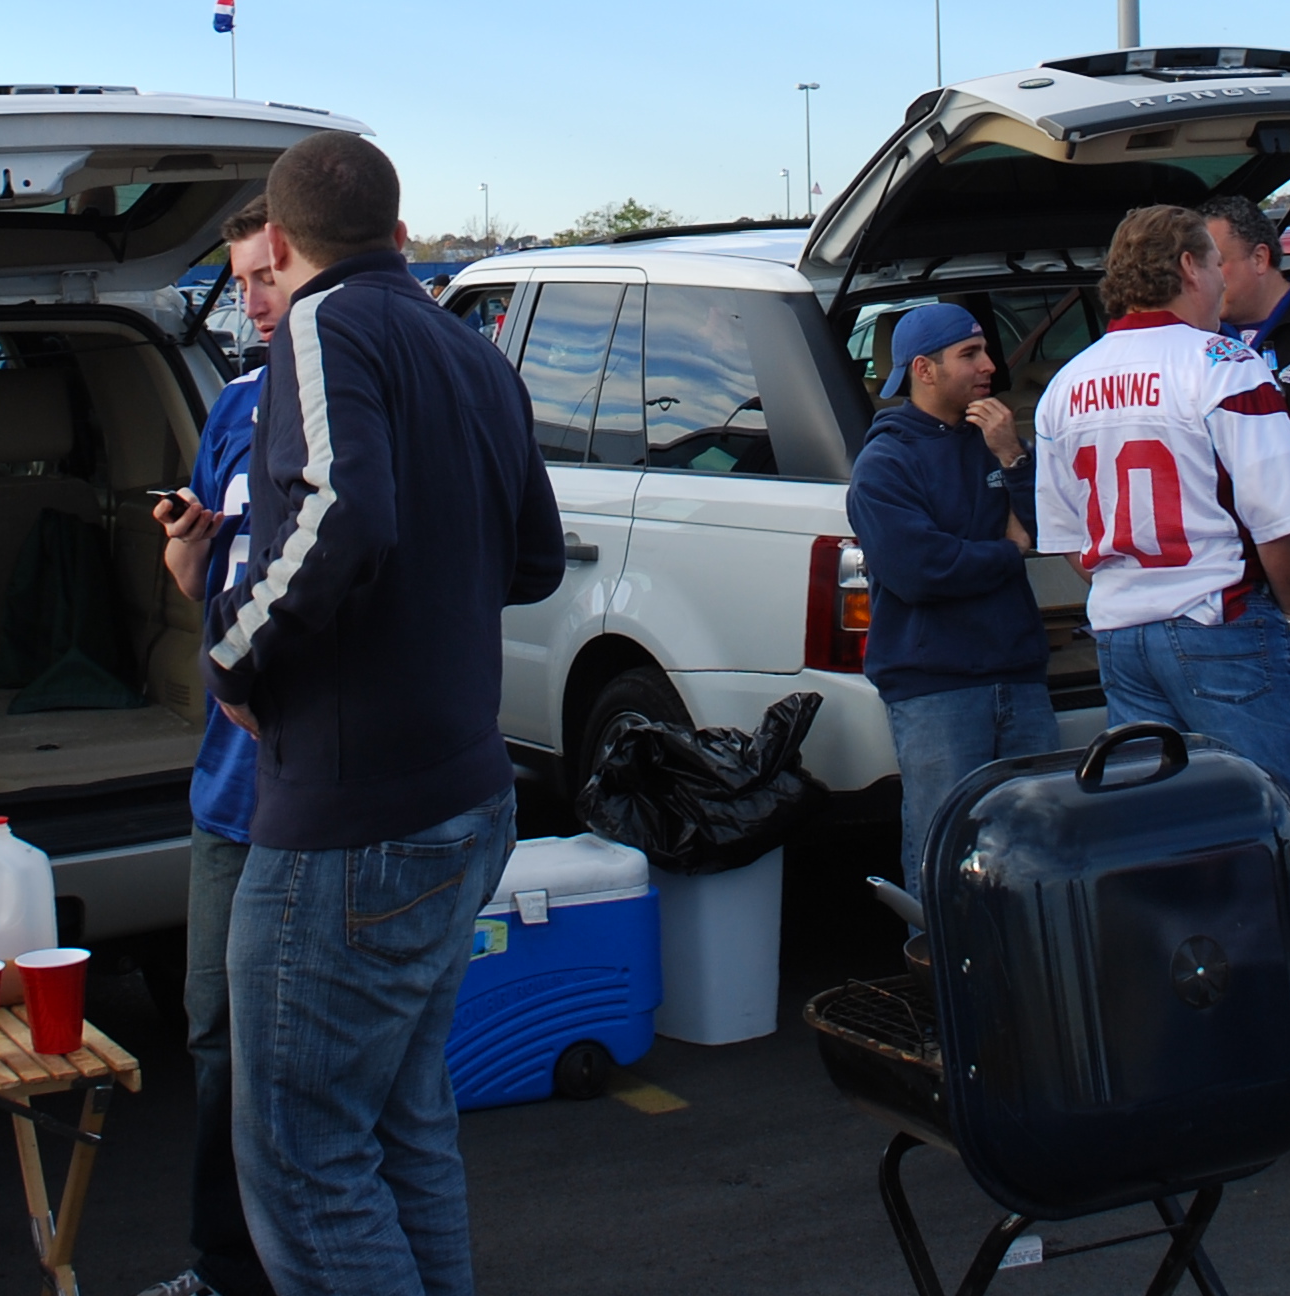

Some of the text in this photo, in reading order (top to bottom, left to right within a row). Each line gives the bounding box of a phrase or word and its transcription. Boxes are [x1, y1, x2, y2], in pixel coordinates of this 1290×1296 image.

[1129, 85, 1271, 108] RANGE
[1070, 373, 1160, 417] MANNING
[1072, 439, 1193, 571] 10
